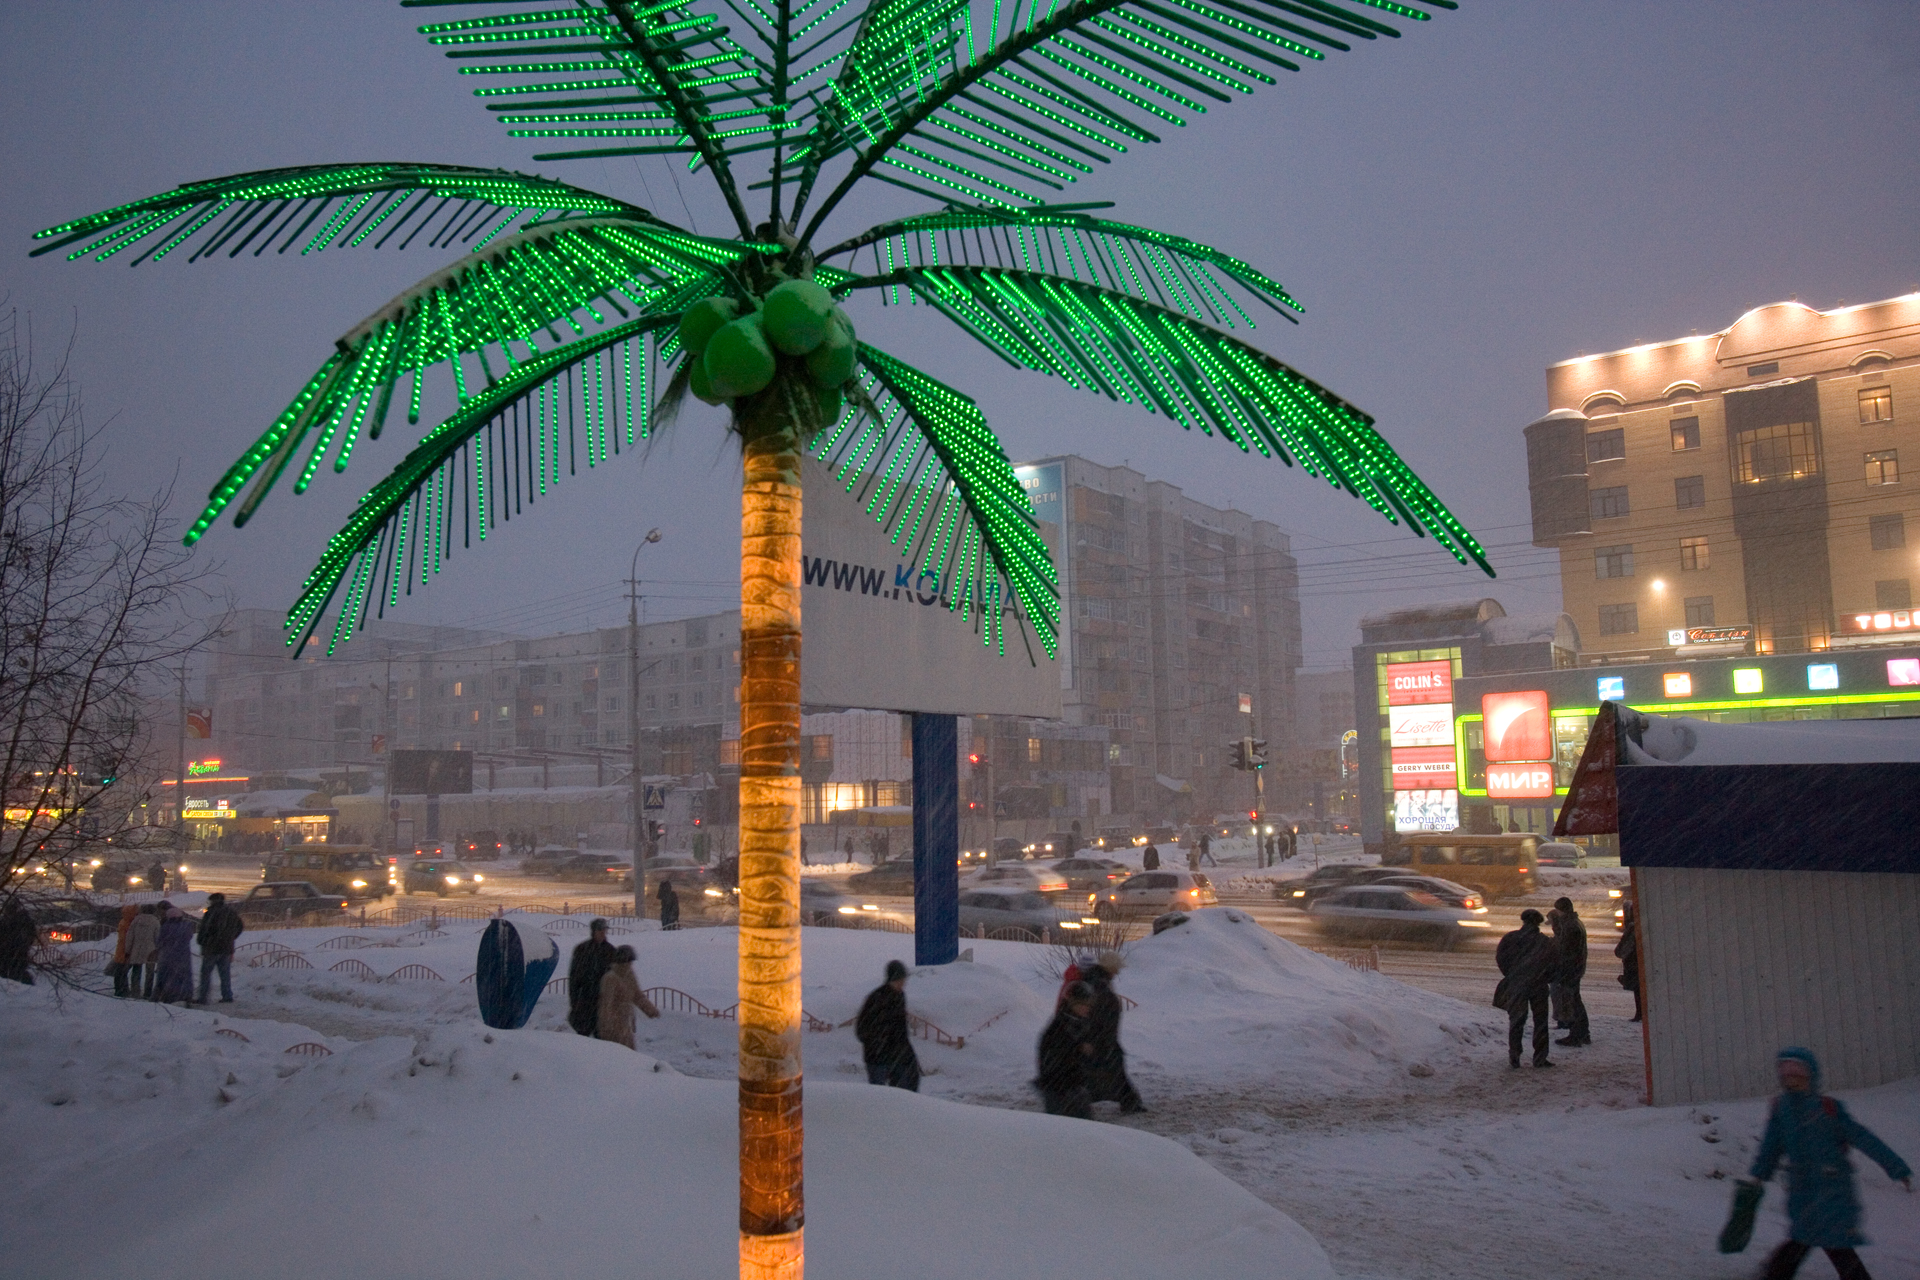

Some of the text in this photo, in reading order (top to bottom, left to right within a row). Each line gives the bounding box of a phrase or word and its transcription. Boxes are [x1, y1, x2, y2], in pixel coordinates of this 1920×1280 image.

[1393, 719, 1449, 735] Lisette
[1398, 816, 1446, 824] ХОРОШАЯ
[1424, 823, 1456, 831] ПОСУДА
